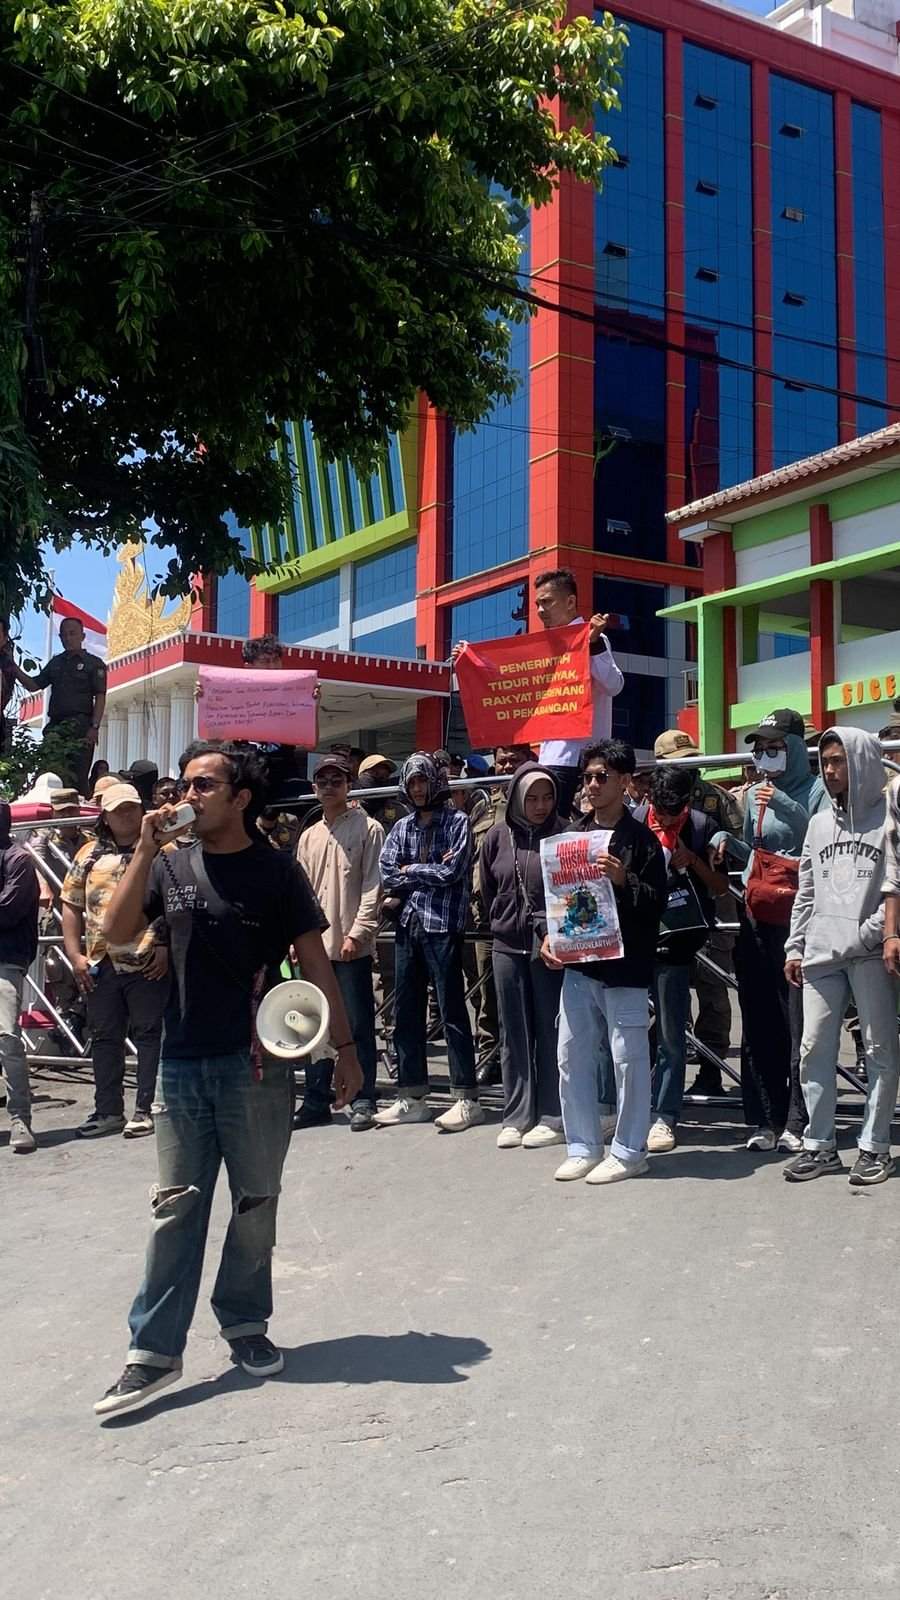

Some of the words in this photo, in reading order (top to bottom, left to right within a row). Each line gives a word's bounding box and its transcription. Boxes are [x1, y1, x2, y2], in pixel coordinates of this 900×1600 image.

[500, 655, 571, 674] PEMERINTAH
[488, 678, 529, 691] TIDUR
[532, 669, 579, 685] NYENYAK,
[482, 692, 533, 707] RAKYAT
[535, 685, 585, 700] BERENANG
[496, 711, 510, 721] DI
[512, 701, 578, 719] PEKARANGAN
[556, 840, 589, 856] JANGAN
[560, 850, 588, 869] RUSAK
[552, 868, 576, 885] BUMI
[167, 885, 197, 896] CARI
[167, 901, 207, 912] BARU
